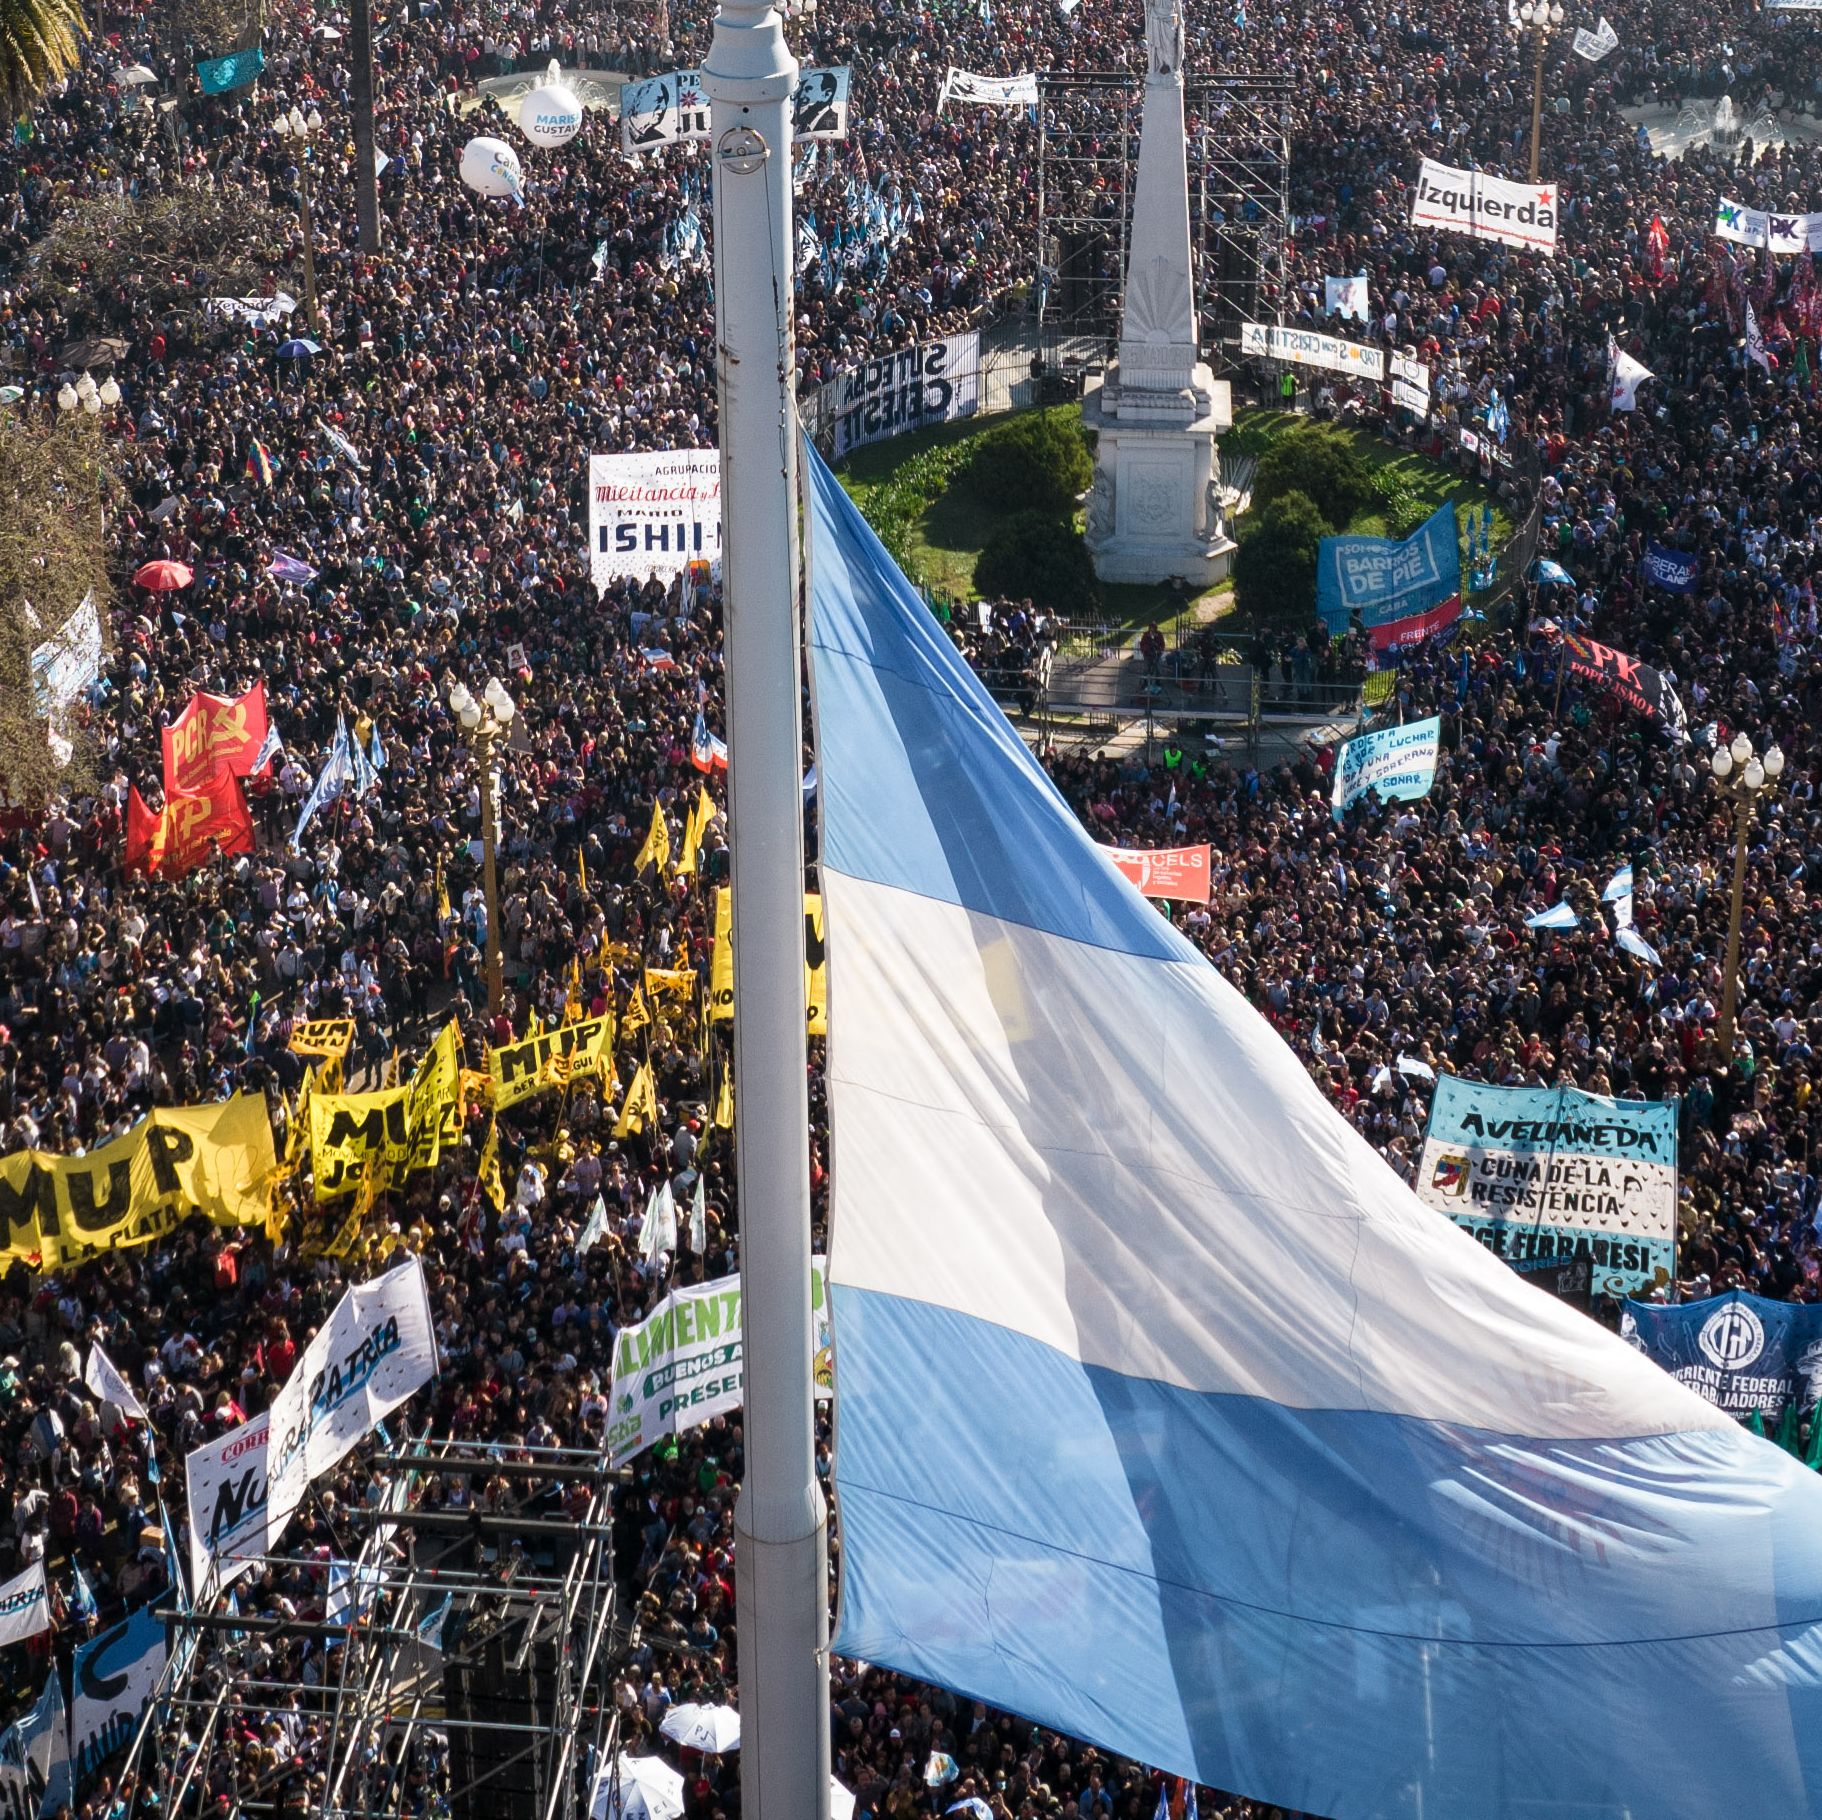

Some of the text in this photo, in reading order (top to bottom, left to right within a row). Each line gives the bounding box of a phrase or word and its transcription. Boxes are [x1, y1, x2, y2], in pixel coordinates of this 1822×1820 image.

[534, 124, 581, 135] GUSTAV
[1418, 177, 1555, 230] Izquierda
[594, 482, 697, 503] Militancia
[618, 509, 683, 517] MARIO
[1344, 543, 1390, 556] SOMS
[1346, 542, 1419, 575] BARRIOS
[1348, 561, 1426, 594] DE PIE
[1379, 599, 1408, 616] CABA
[1400, 621, 1440, 641] FRENTE
[1588, 639, 1644, 691] PK
[1570, 660, 1646, 712] POPISMO
[172, 708, 212, 779] PCR
[1389, 731, 1435, 749] LUCHAR
[1152, 853, 1203, 868] CELS
[498, 1021, 602, 1084] MUP
[324, 1099, 408, 1149] MU
[1459, 1112, 1658, 1154] AVELLANEDA
[1479, 1157, 1612, 1188] CUNA DE LA
[1470, 1180, 1621, 1216] RESISTENCIA
[61, 1203, 180, 1263] LA PLATA
[1518, 1230, 1650, 1273] FERRARESI
[311, 1315, 401, 1417] PATRIA
[650, 1350, 722, 1391] BUENOS
[1731, 1375, 1795, 1394] FEDERAL
[658, 1373, 743, 1421] PRESE
[220, 1425, 271, 1465] CORR
